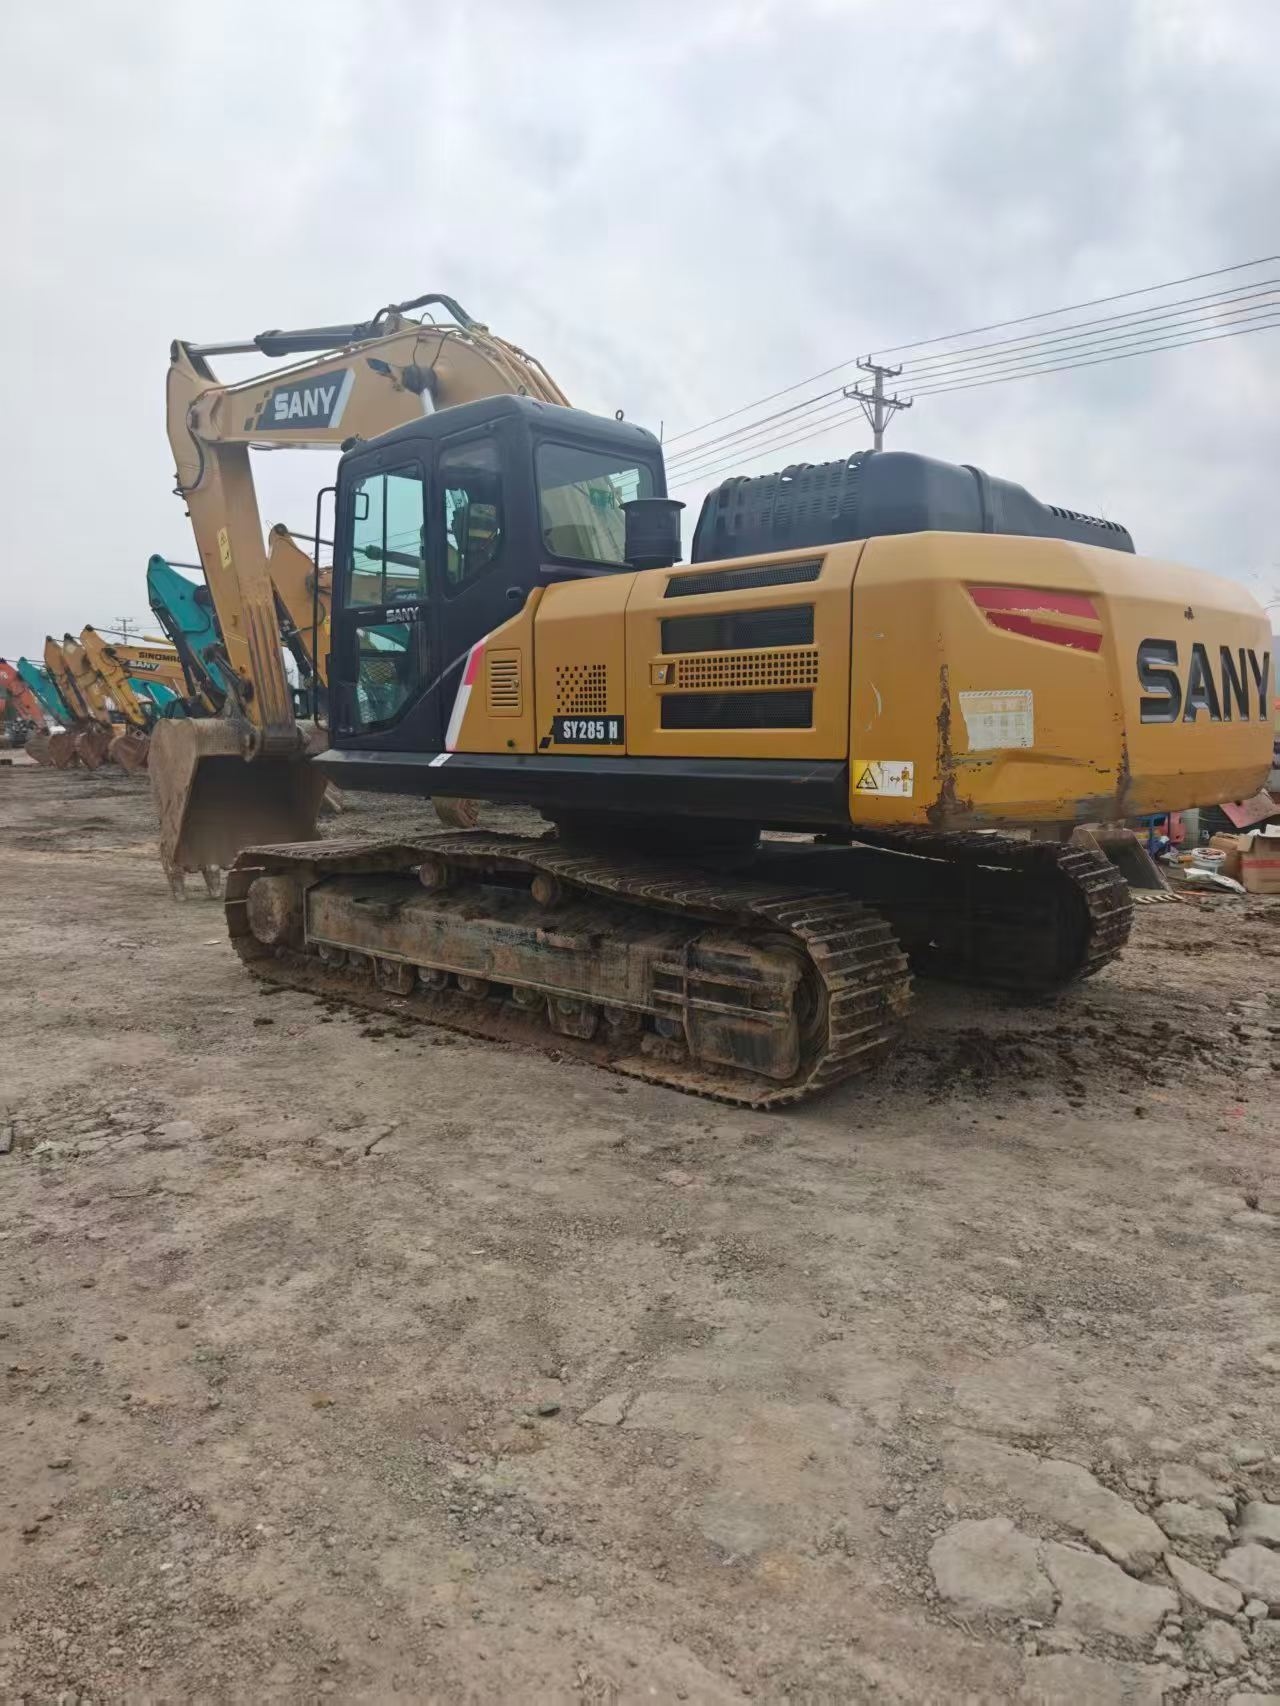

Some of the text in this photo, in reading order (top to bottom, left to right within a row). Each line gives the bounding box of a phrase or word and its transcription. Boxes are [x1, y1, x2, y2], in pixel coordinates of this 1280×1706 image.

[274, 386, 336, 421] SANY
[386, 606, 420, 623] SANY
[128, 660, 156, 669] SANY
[1136, 637, 1270, 725] SANY
[563, 720, 618, 739] SY285 H
